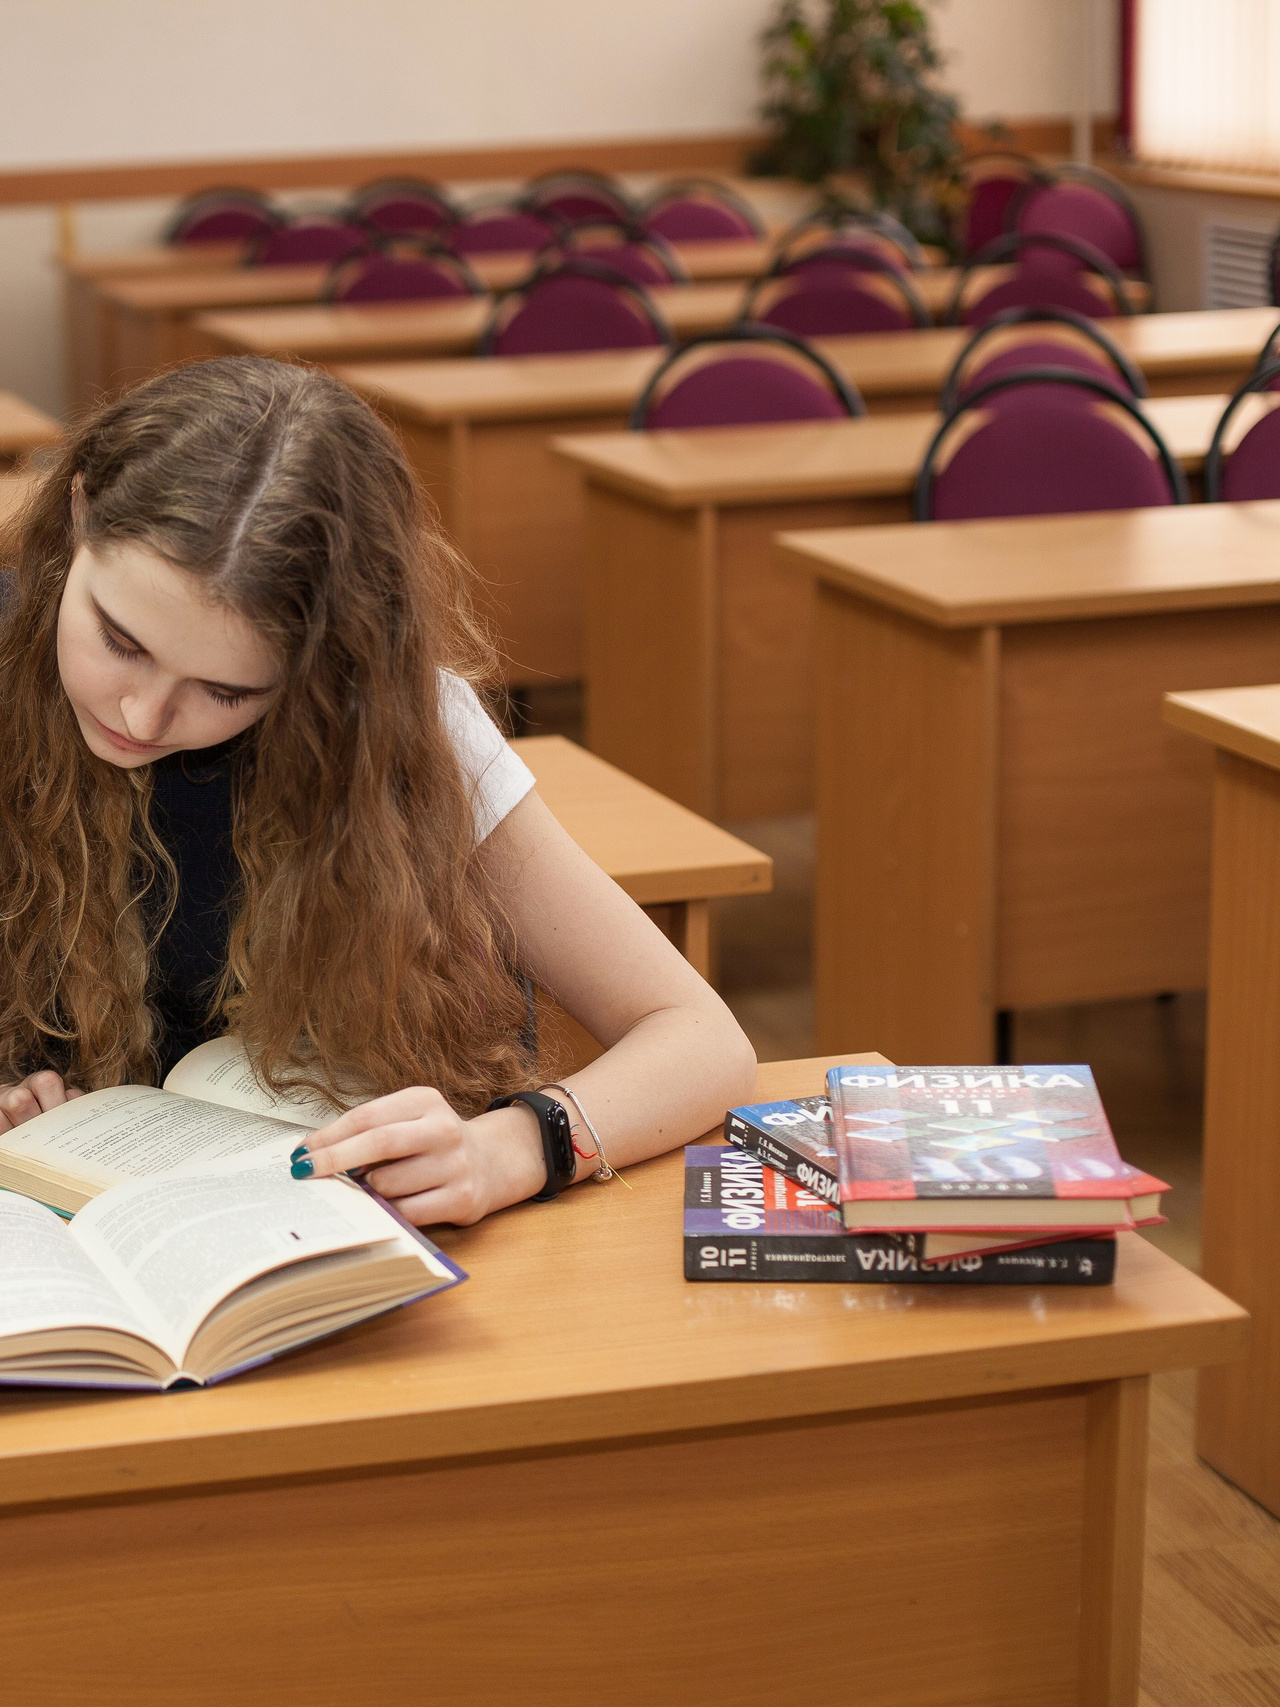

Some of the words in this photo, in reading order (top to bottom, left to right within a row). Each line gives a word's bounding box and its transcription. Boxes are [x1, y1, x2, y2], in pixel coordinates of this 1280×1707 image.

[840, 1074, 1084, 1088] ФИЗИКА
[938, 1099, 994, 1114] 11
[729, 1117, 746, 1146] 11
[720, 1151, 766, 1230] ФИЗИКА
[796, 1163, 841, 1206] ФИЗИ
[700, 1246, 719, 1269] 10
[728, 1248, 747, 1267] 11
